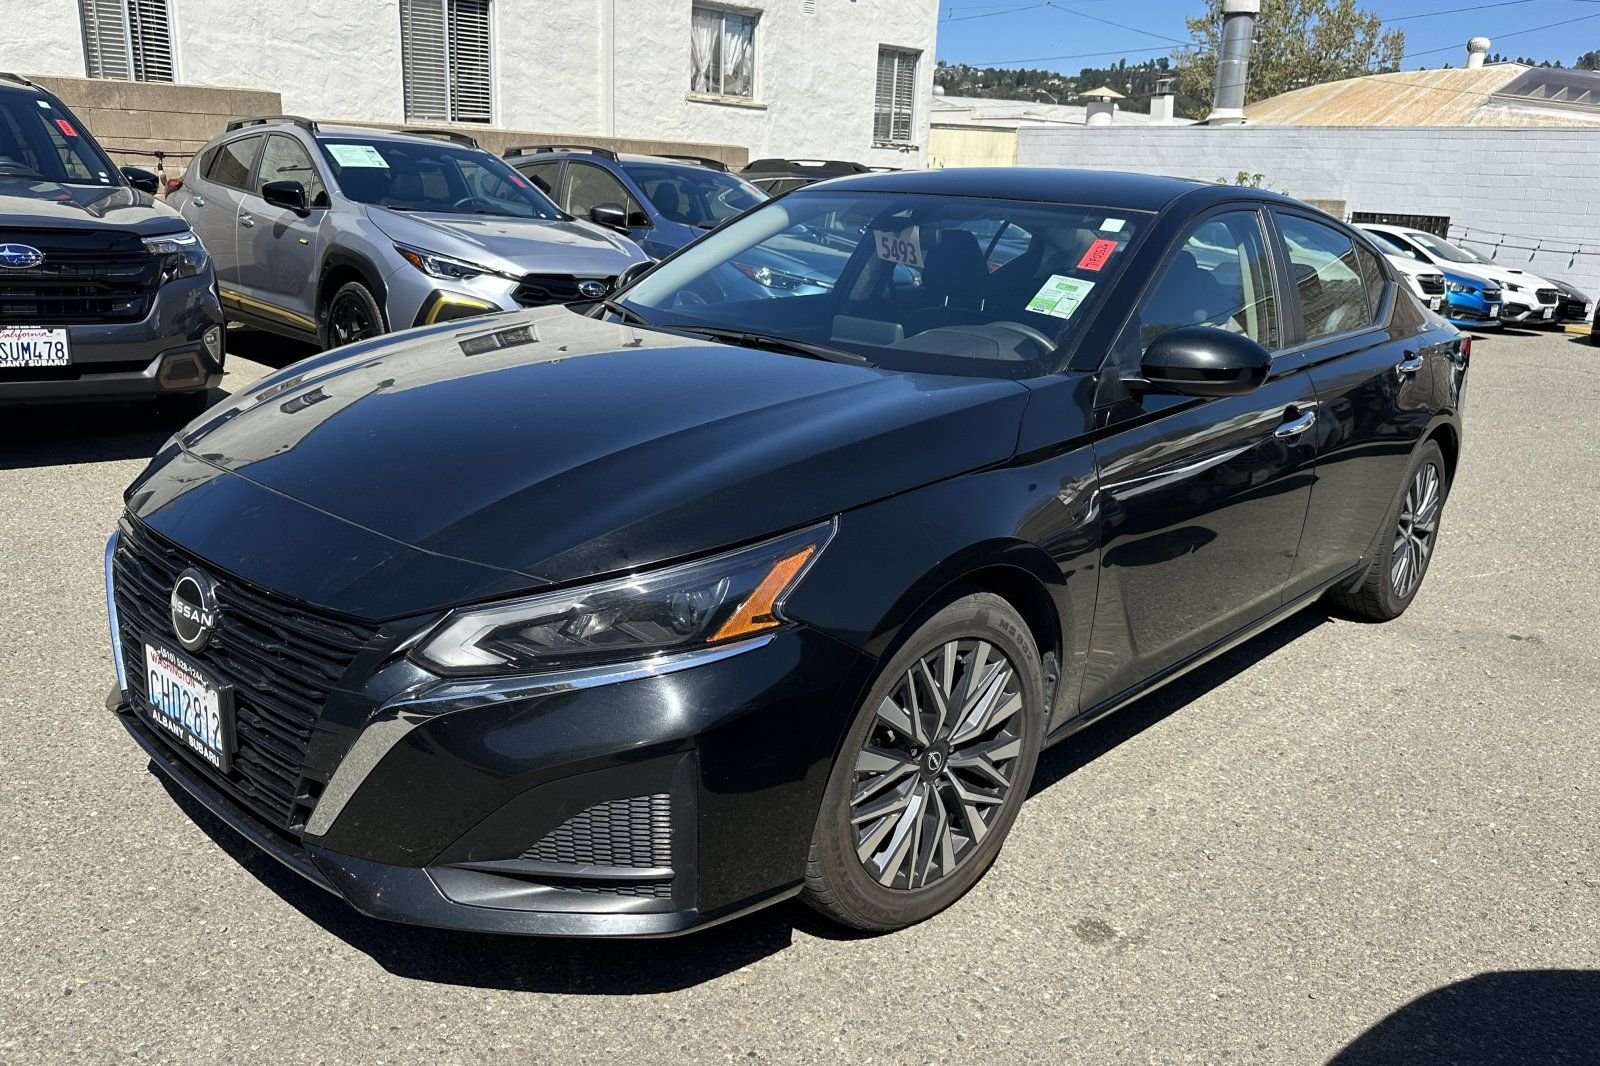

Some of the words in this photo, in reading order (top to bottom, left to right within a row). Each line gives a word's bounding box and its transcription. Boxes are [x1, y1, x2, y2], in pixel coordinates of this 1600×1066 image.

[881, 237, 918, 265] 5493
[28, 359, 67, 367] SUBARU
[999, 619, 1017, 637] MS
[150, 650, 196, 688] WASHINGTON
[150, 669, 222, 752] CHD2812
[152, 710, 184, 739] ALBANY
[188, 735, 220, 767] SUBARU
